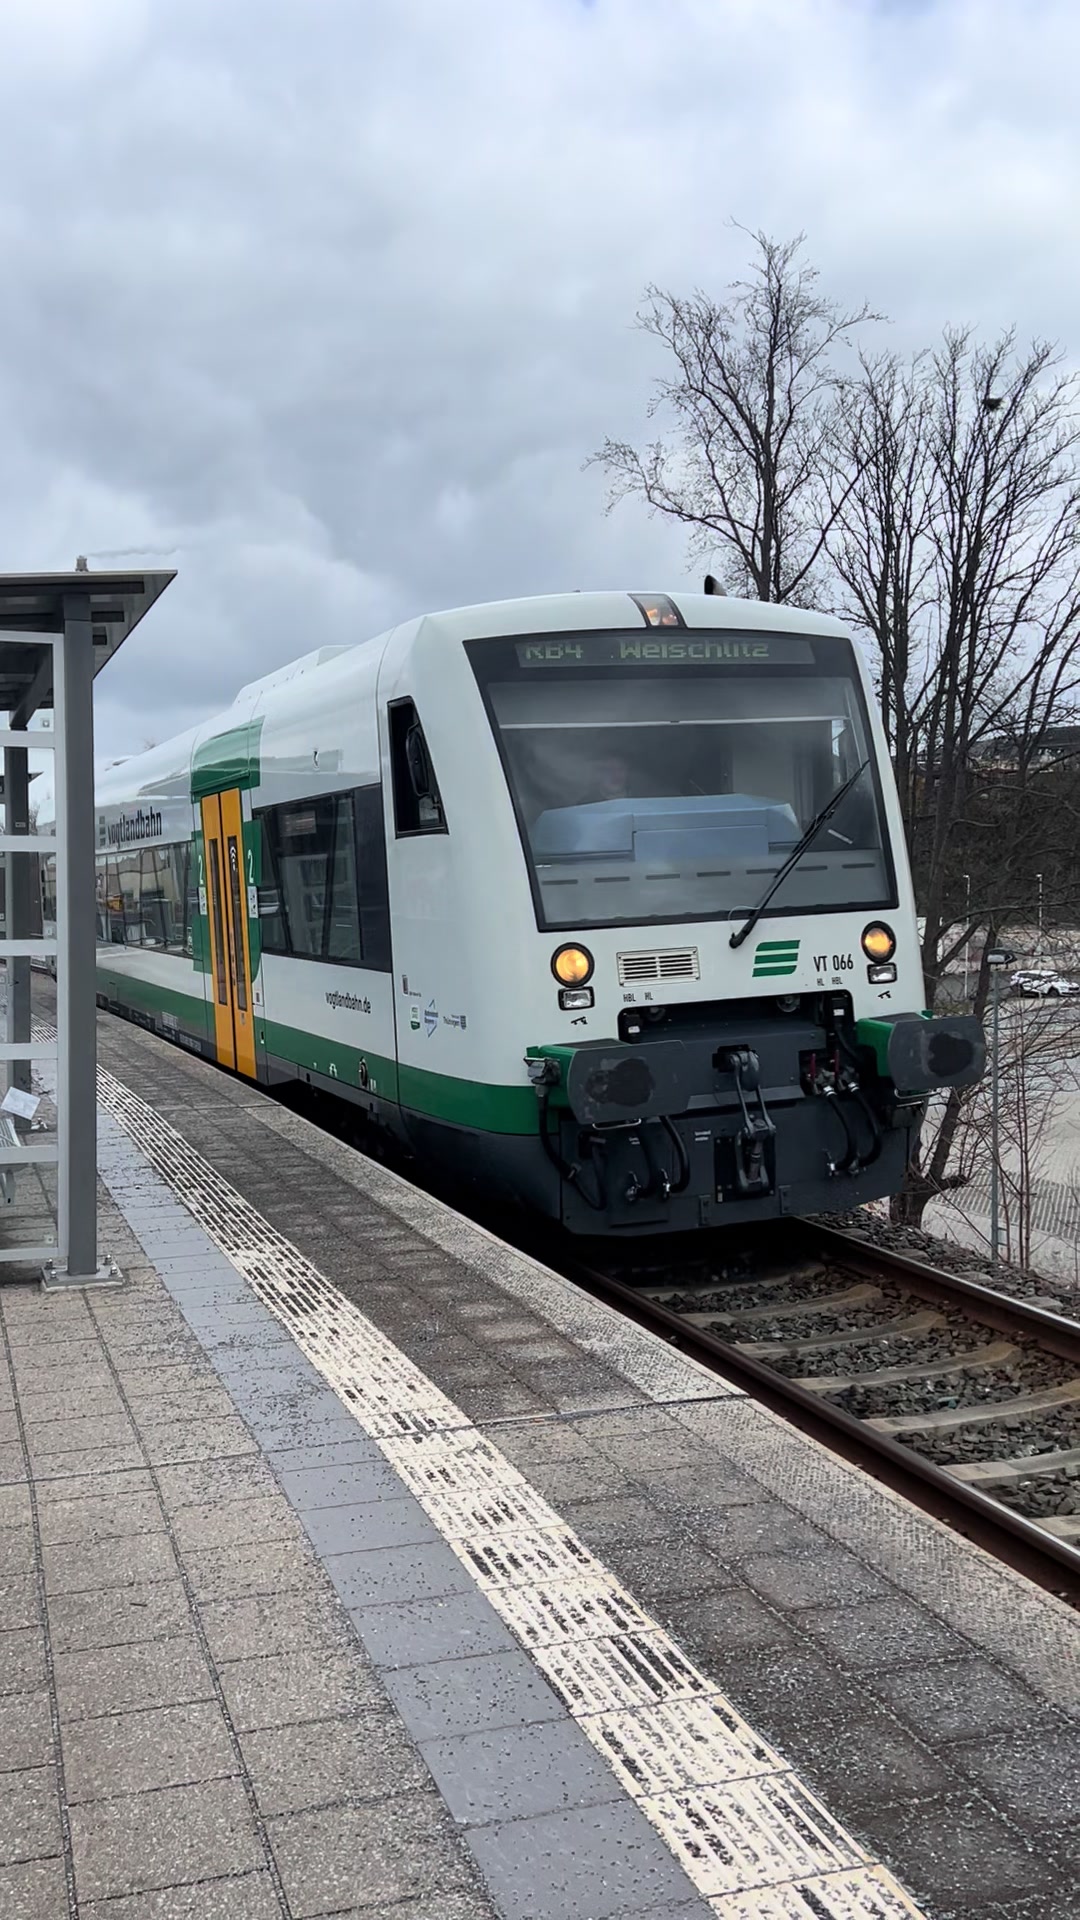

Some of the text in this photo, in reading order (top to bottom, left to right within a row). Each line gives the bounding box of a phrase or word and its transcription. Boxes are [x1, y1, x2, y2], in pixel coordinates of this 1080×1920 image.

[107, 806, 162, 850] vogtlandbahn
[247, 849, 255, 884] 2
[813, 953, 854, 972] VT 066
[325, 990, 371, 1014] vogtlandbahn.de
